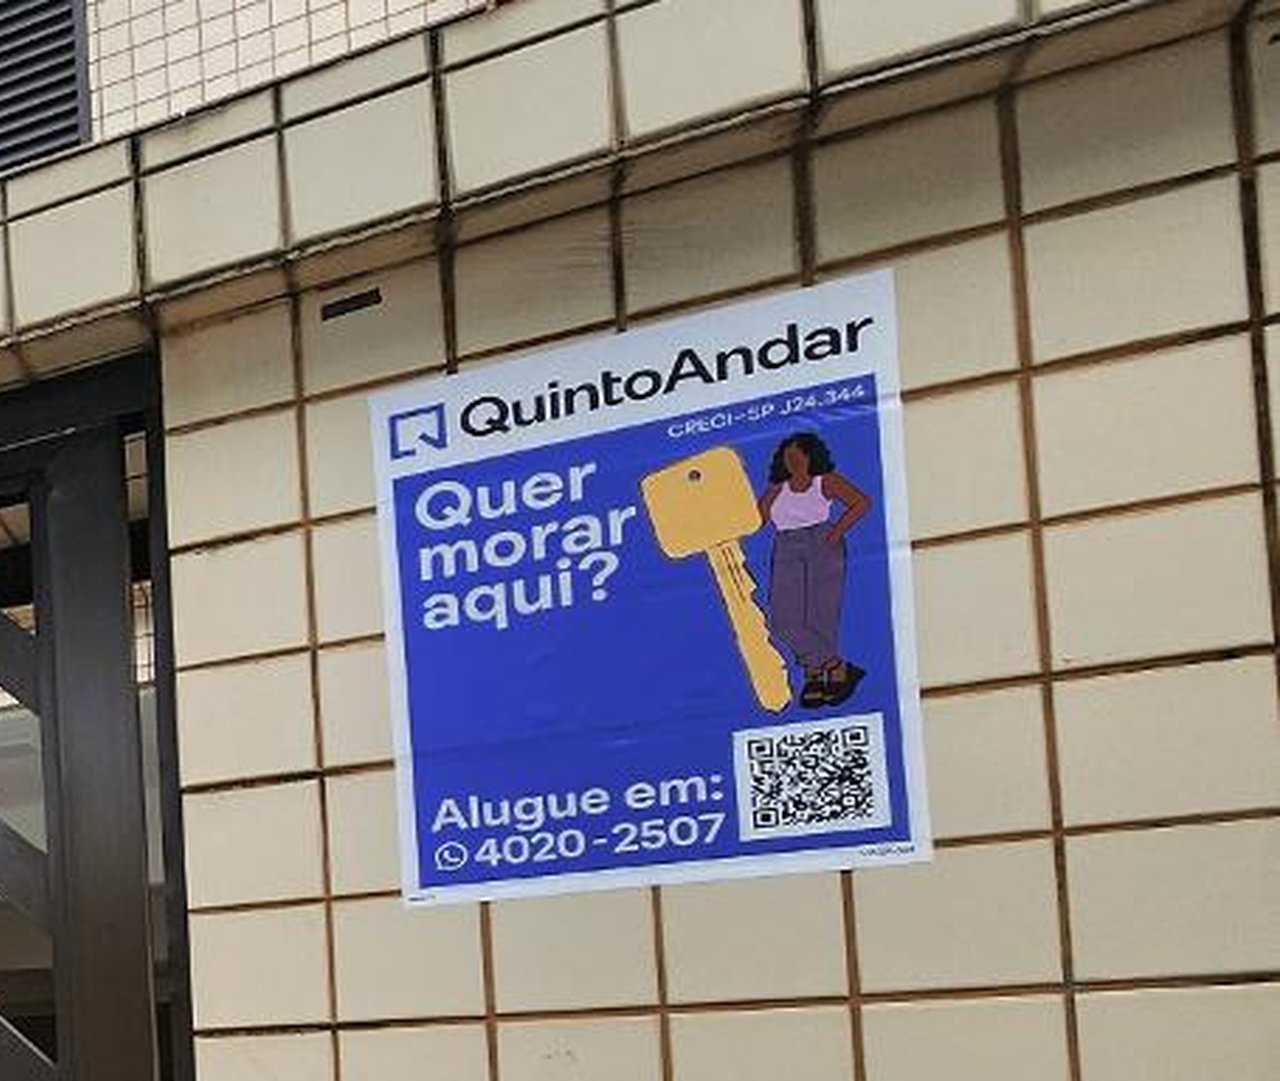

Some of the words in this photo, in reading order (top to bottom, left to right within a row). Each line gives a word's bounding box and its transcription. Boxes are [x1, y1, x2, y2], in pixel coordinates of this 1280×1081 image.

[459, 316, 874, 438] QuintoAndar
[666, 403, 776, 439] CRECI-SP
[414, 462, 598, 531] Quer
[418, 505, 637, 582] morar
[422, 550, 620, 631] aqui?
[431, 787, 611, 833] Alugue
[624, 773, 725, 810] em:
[473, 812, 727, 867] 4020-2507
